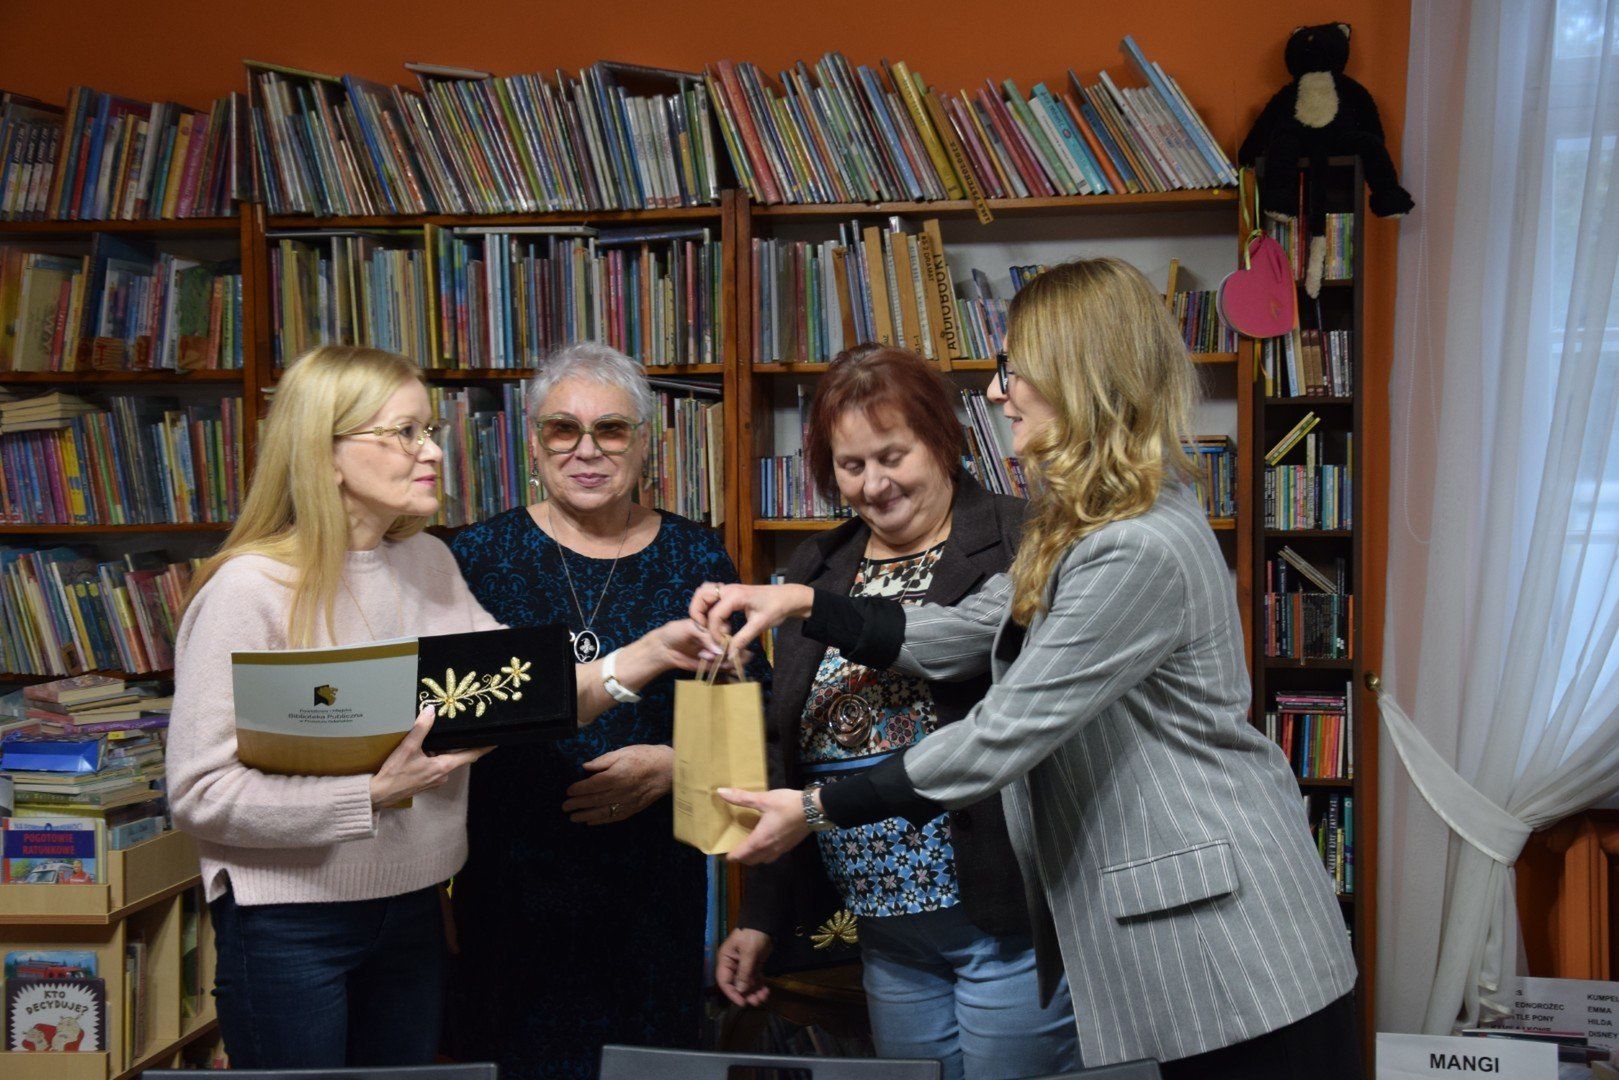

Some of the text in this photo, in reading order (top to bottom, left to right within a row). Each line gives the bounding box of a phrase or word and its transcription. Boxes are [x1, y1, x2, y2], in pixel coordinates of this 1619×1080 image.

[923, 252, 934, 282] DRAMAT
[933, 254, 957, 350] AUDIOBOOKI
[44, 990, 66, 999] KTO
[26, 1000, 89, 1015] DECYDUJE?
[1515, 1002, 1565, 1011] EDNOROŻEC
[1587, 1006, 1612, 1014] EMMA
[1532, 1014, 1554, 1022] PONY
[1587, 1019, 1613, 1027] HILDA
[1588, 1030, 1618, 1039] DISNEY
[1430, 1053, 1499, 1073] MANGI
